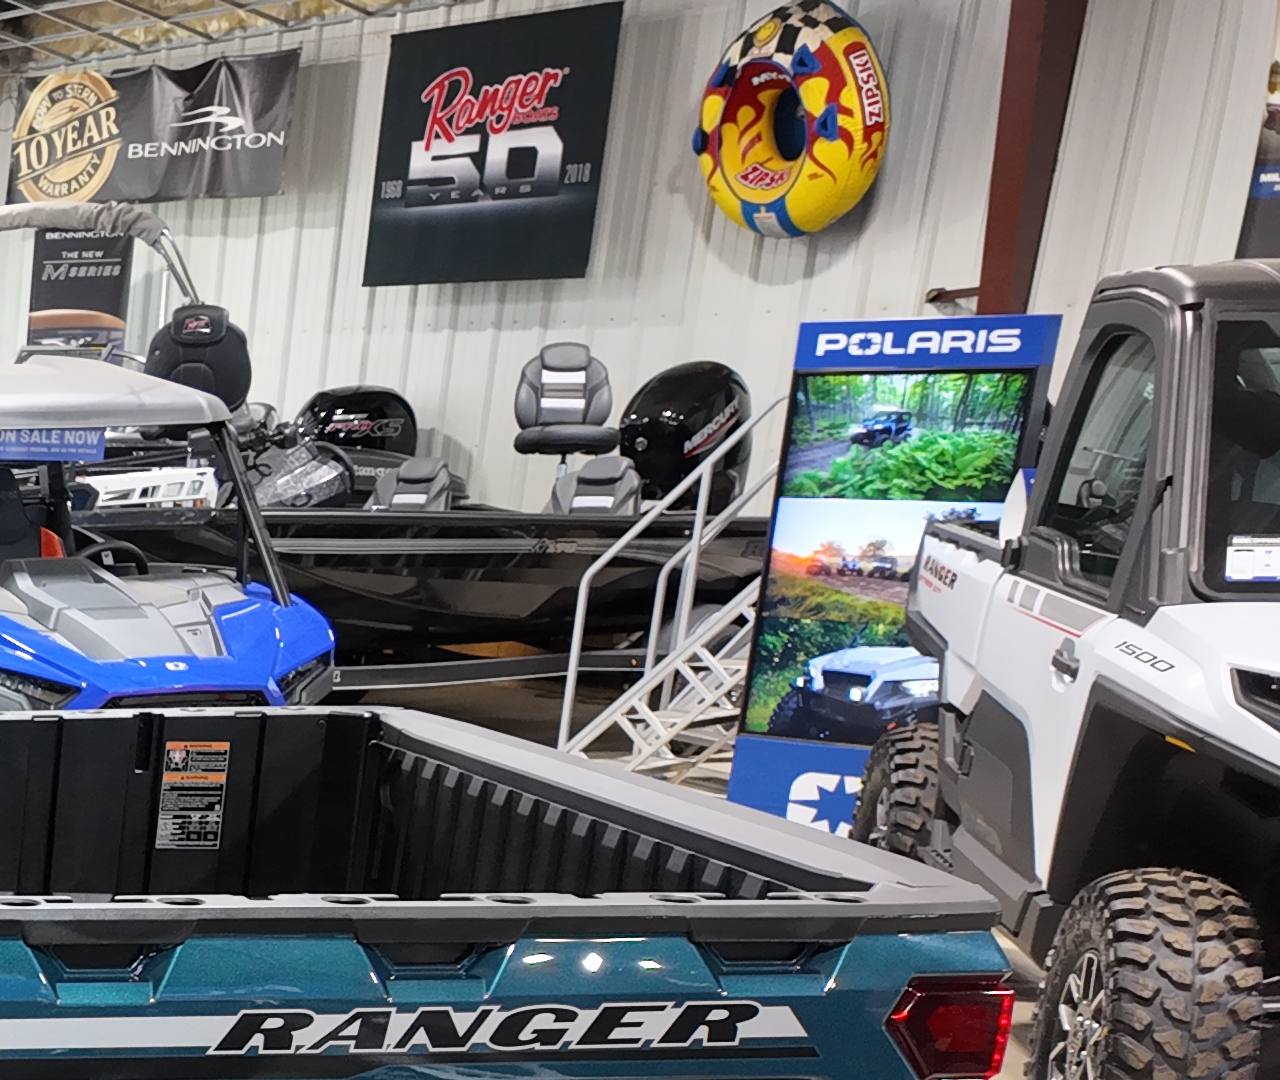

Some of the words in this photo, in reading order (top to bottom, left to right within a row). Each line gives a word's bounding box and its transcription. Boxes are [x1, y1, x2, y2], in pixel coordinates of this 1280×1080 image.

[65, 83, 98, 106] STERN
[849, 50, 883, 126] ZIPSKI
[421, 67, 562, 151] Ranger
[13, 136, 49, 177] 10
[51, 106, 119, 159] YEAR
[127, 131, 285, 158] BENNINGTON
[38, 154, 100, 196] WARRANTY
[404, 126, 563, 208] 50
[564, 163, 591, 184] 2018
[428, 185, 532, 200] YEARS
[68, 265, 121, 277] SERIES
[815, 328, 1022, 356] POLARIS
[20, 430, 61, 444] SALE
[64, 430, 101, 445] NOW
[683, 394, 739, 454] MERCURY
[1114, 641, 1175, 672] 1500
[207, 1002, 760, 1055] RANGER
